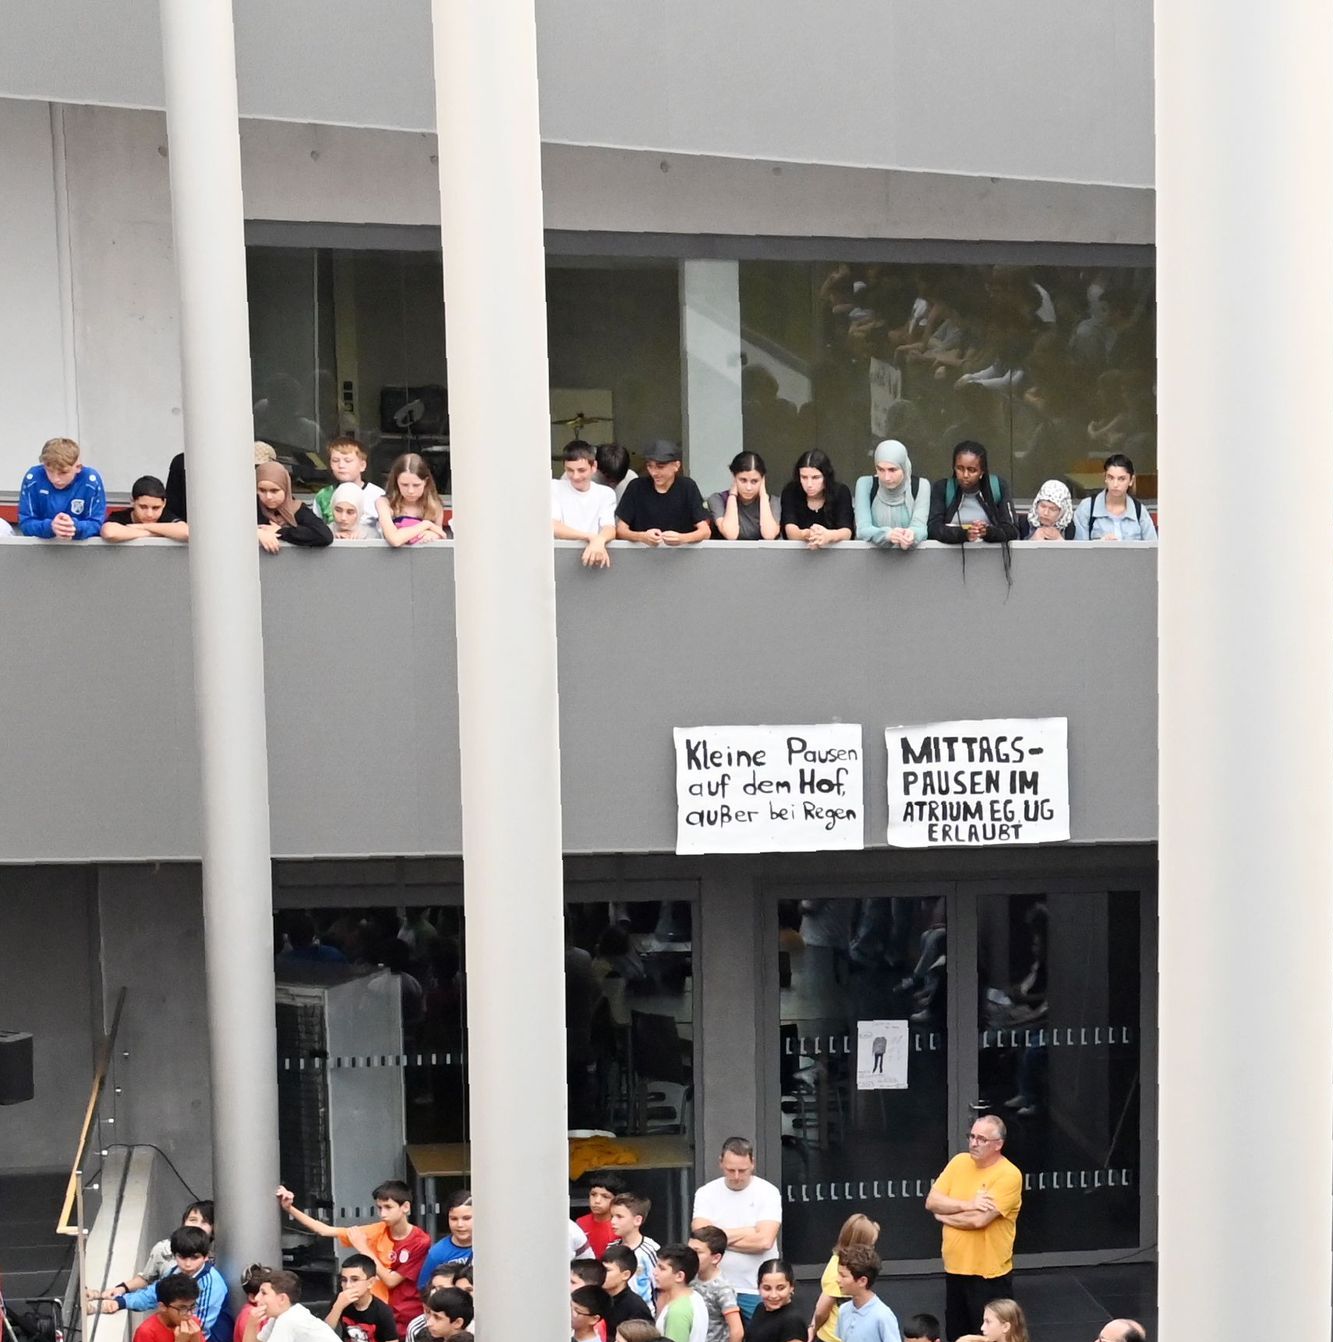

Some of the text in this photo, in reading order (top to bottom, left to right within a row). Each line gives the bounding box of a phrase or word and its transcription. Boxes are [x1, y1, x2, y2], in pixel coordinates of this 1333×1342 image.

[685, 737, 859, 770] Kleine Pausen
[900, 736, 1044, 765] MITTAGS-
[688, 769, 732, 798] auf
[742, 770, 792, 795] dem
[902, 770, 1039, 796] PAUSEN IM
[685, 801, 858, 831] außer bei Regen
[902, 798, 984, 823] ATRIUM
[1023, 798, 1055, 823] UG
[927, 823, 1023, 843] ERLAUBT
